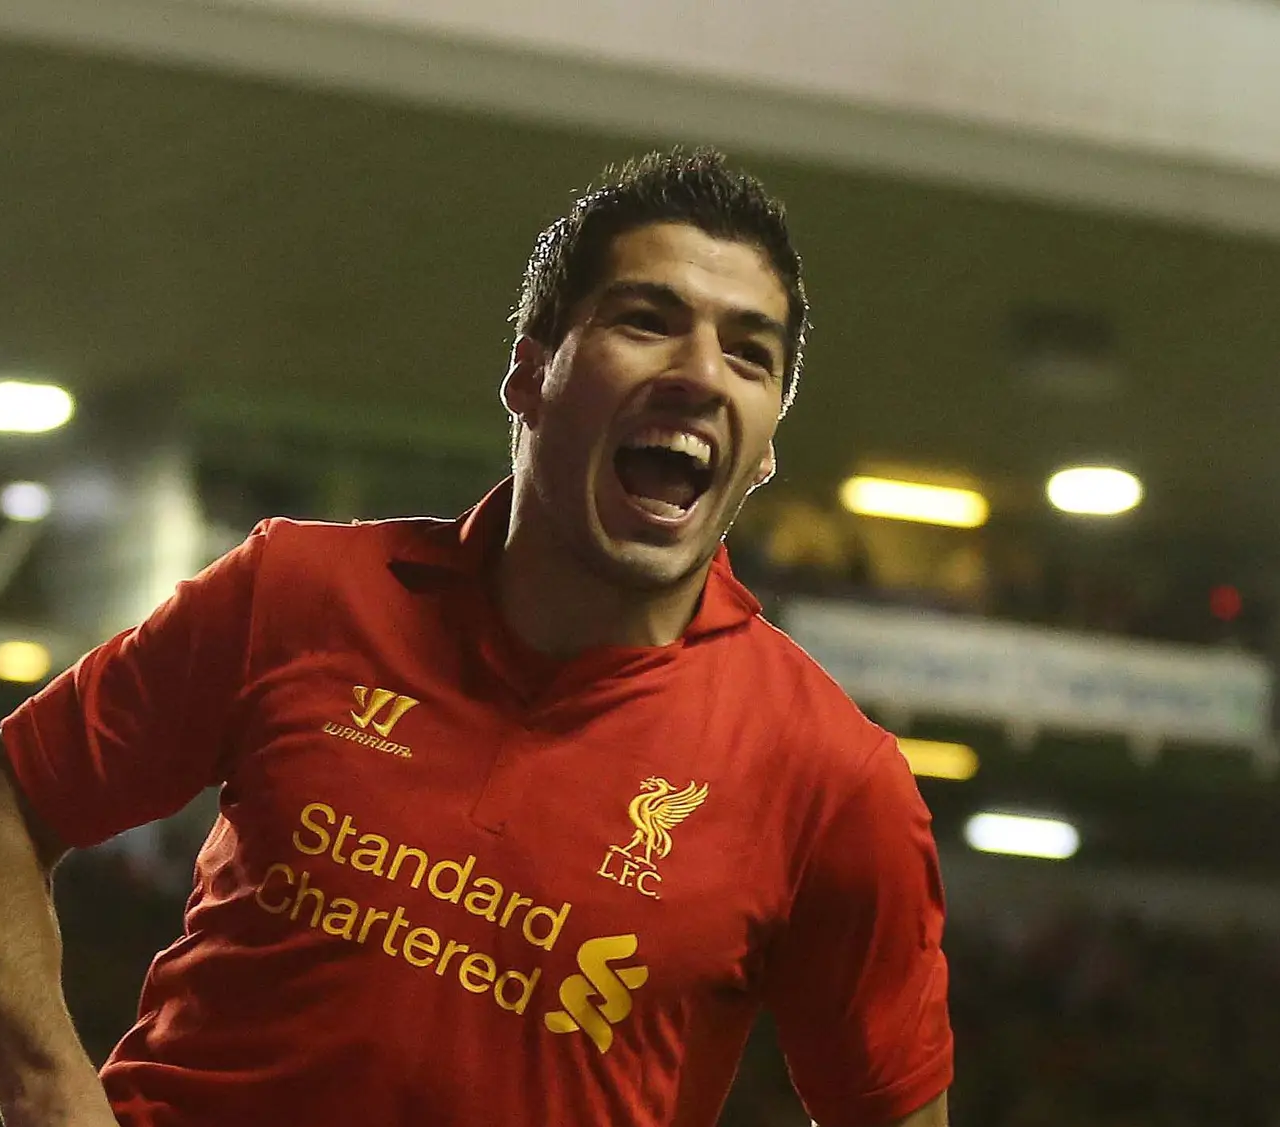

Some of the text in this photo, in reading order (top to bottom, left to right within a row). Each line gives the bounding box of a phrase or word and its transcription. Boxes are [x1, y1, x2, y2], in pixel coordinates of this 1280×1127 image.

[323, 721, 412, 758] WARRIOR
[293, 803, 571, 952] Standard
[597, 851, 662, 899] L.F.C.
[255, 863, 541, 1015] Chartered
